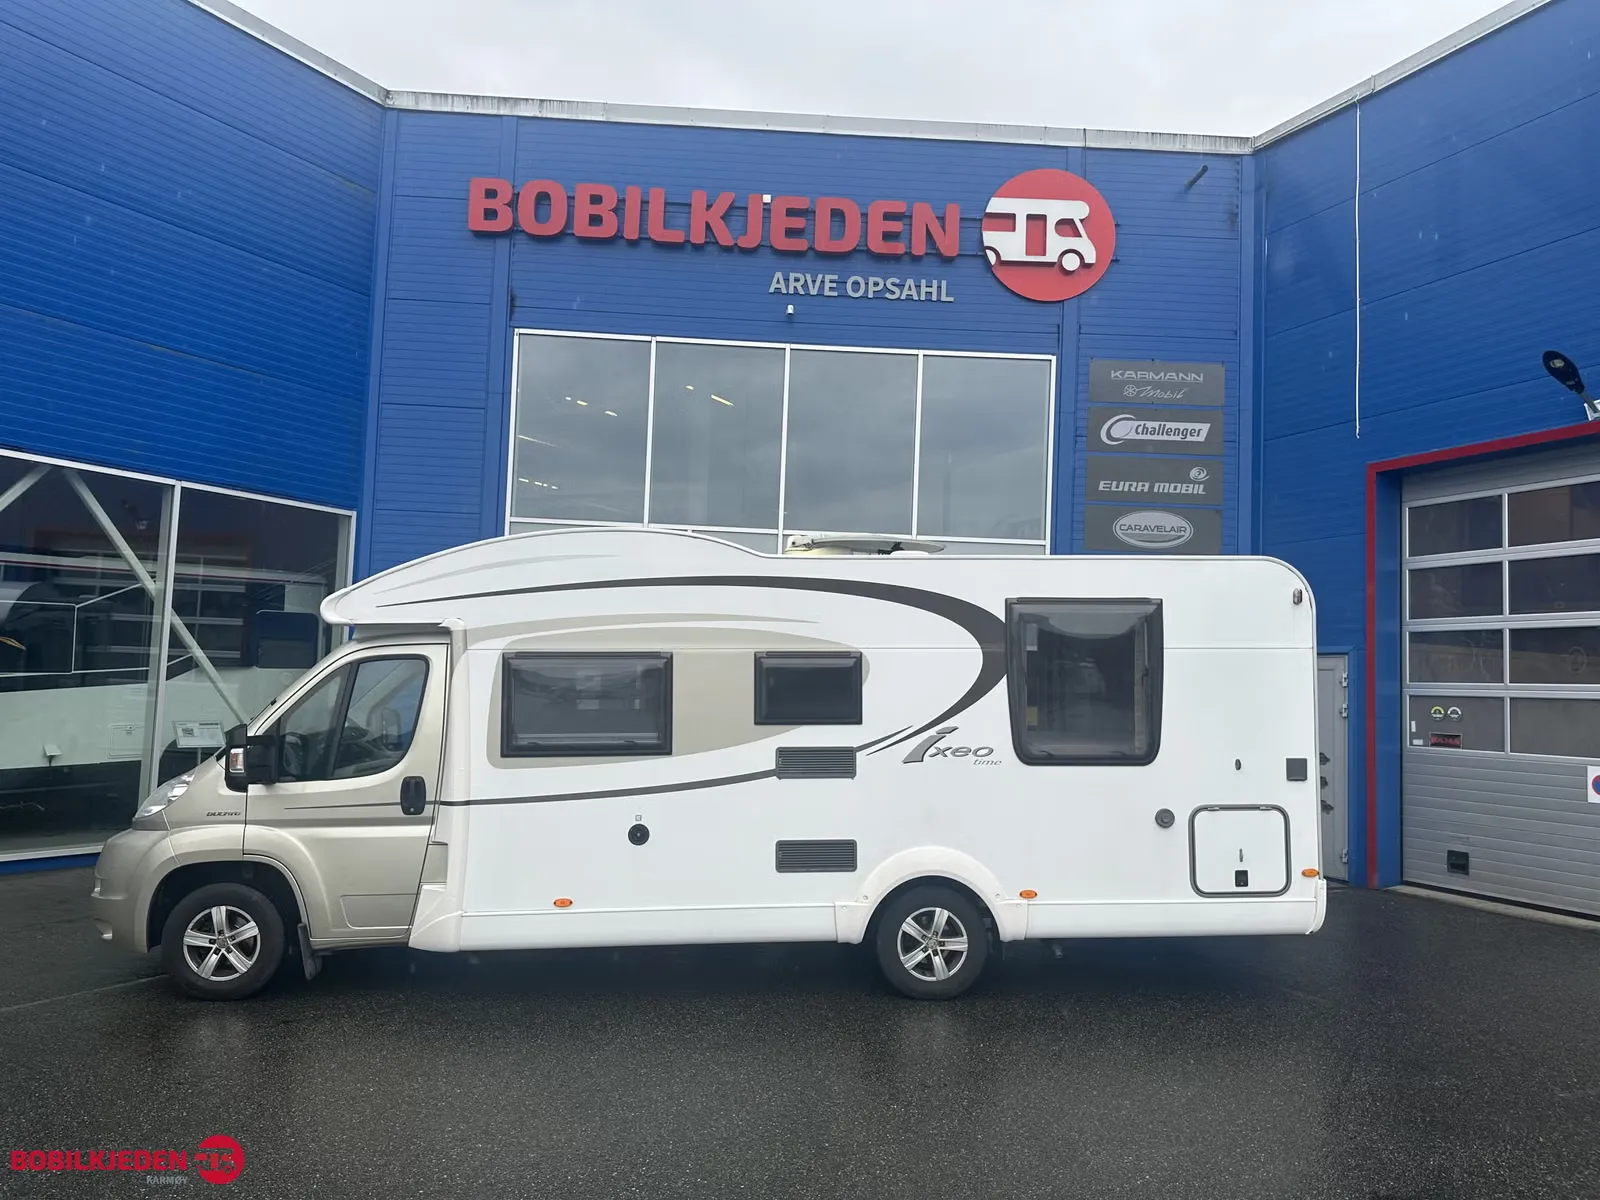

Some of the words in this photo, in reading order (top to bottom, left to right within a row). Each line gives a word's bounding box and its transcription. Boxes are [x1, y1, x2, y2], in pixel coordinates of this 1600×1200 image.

[467, 177, 960, 257] BOBILKJEDEN
[768, 271, 838, 298] ARVE
[845, 276, 955, 302] OPSAHL
[1110, 370, 1204, 383] KARMANN
[1138, 385, 1187, 399] Mobil
[1134, 423, 1203, 440] Challenger
[1098, 480, 1149, 493] EURA
[1153, 482, 1207, 495] MOBIL
[1119, 523, 1187, 534] CARAVELAIR
